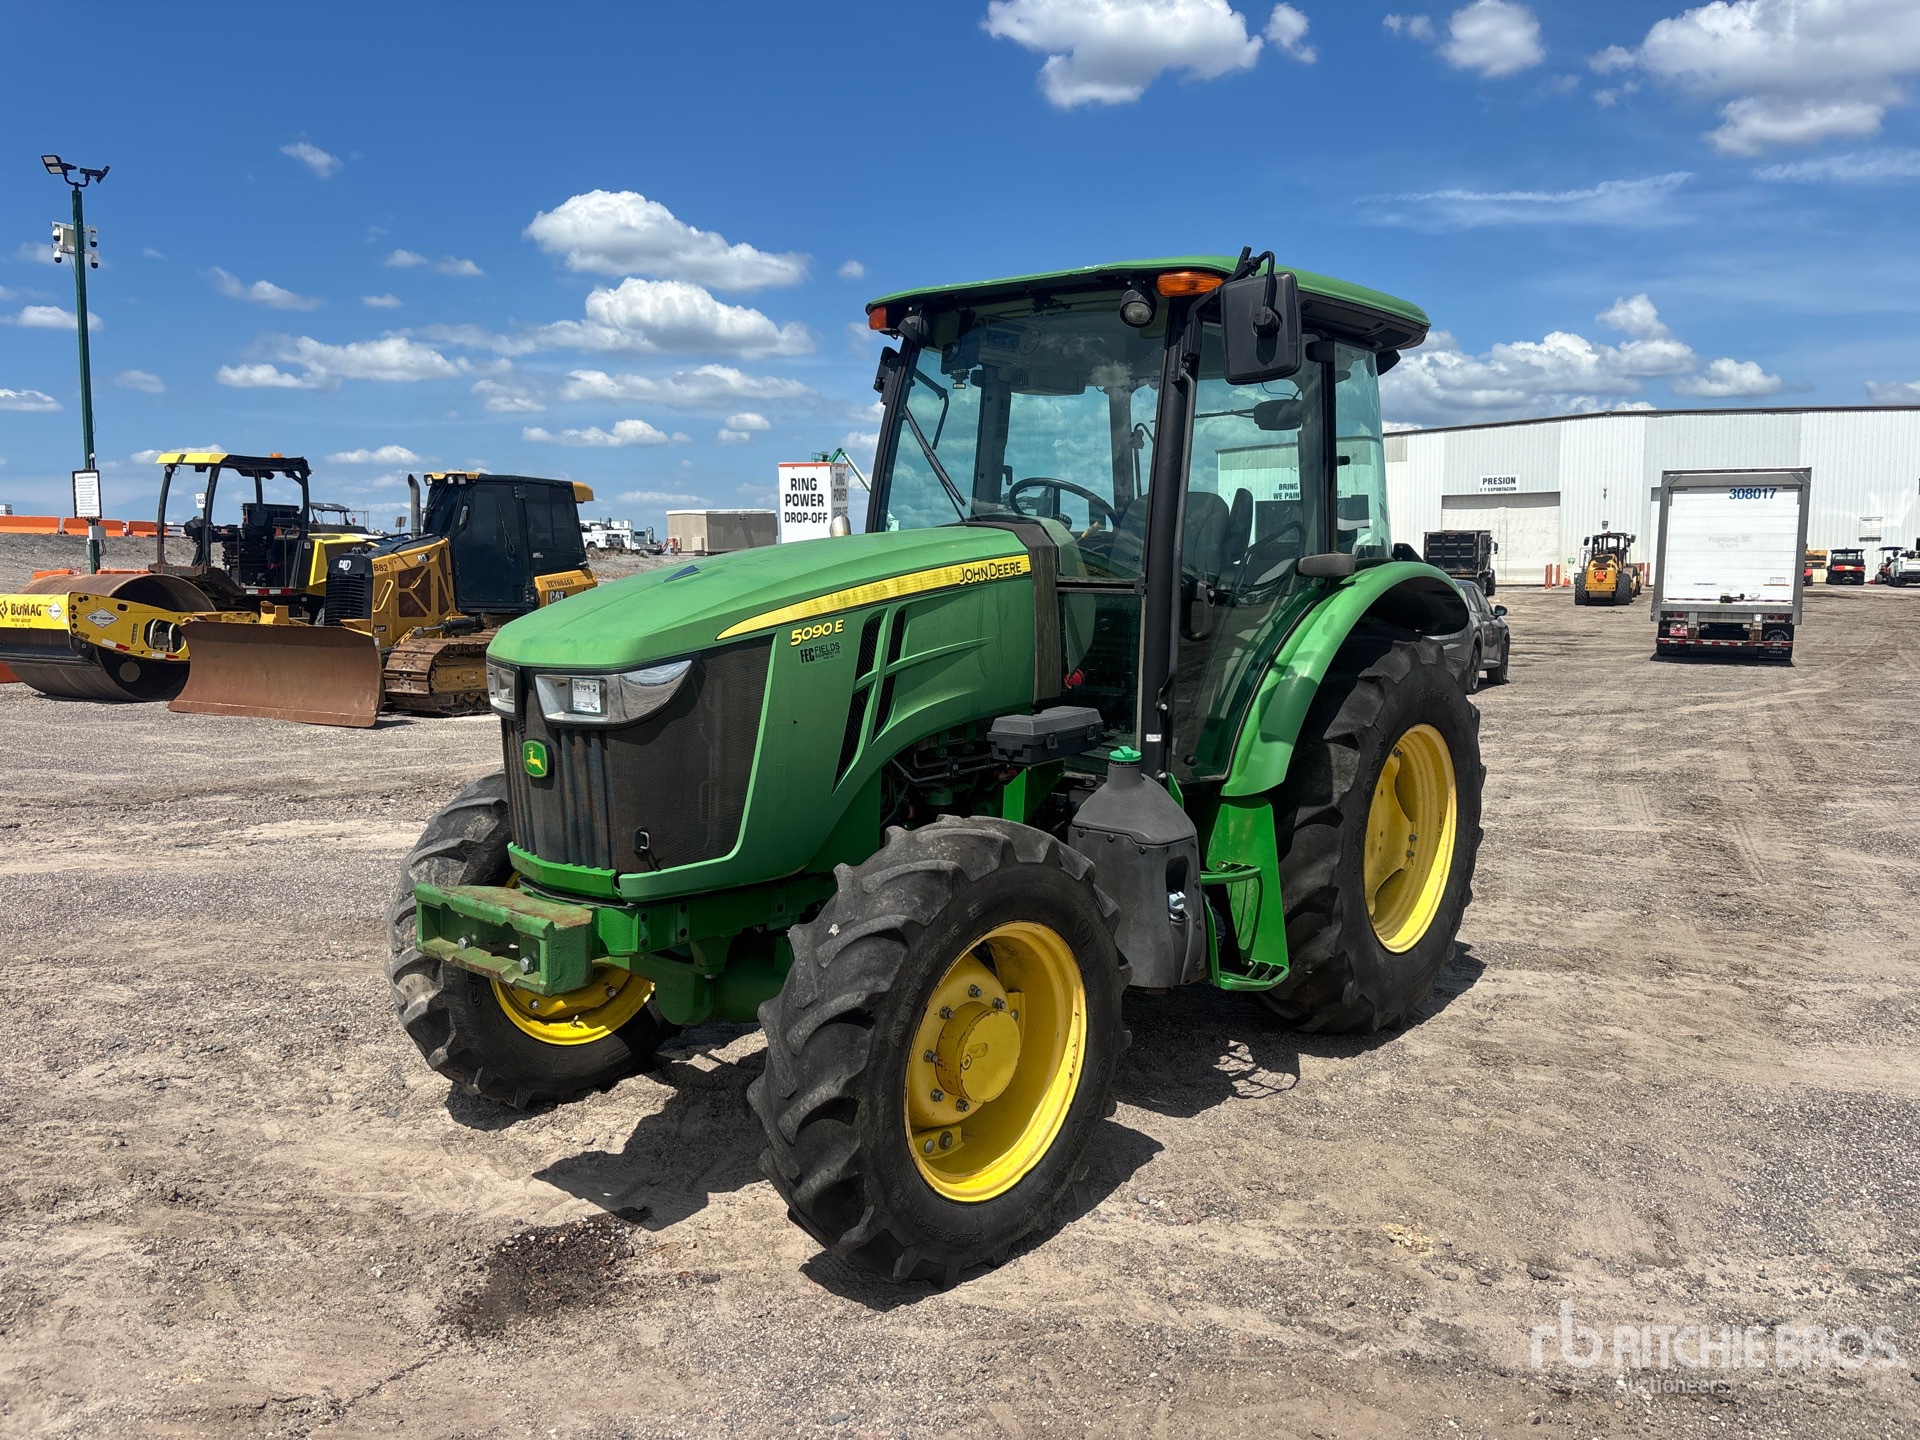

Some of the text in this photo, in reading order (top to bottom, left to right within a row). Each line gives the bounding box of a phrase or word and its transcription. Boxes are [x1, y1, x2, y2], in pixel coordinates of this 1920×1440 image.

[790, 477, 818, 491] RING
[1278, 483, 1298, 491] BRING
[1482, 477, 1516, 485] PRESION
[1273, 492, 1300, 500] WE PAIN
[1729, 487, 1777, 499] 308017
[785, 493, 825, 507] POWER
[784, 512, 828, 524] DROP-OFF
[373, 563, 389, 571] B82
[959, 561, 1022, 583] JOHN DEERE
[550, 591, 565, 602] CAT
[10, 602, 42, 617] BOMAG
[814, 641, 841, 656] FIELDS
[799, 647, 815, 664] FEC
